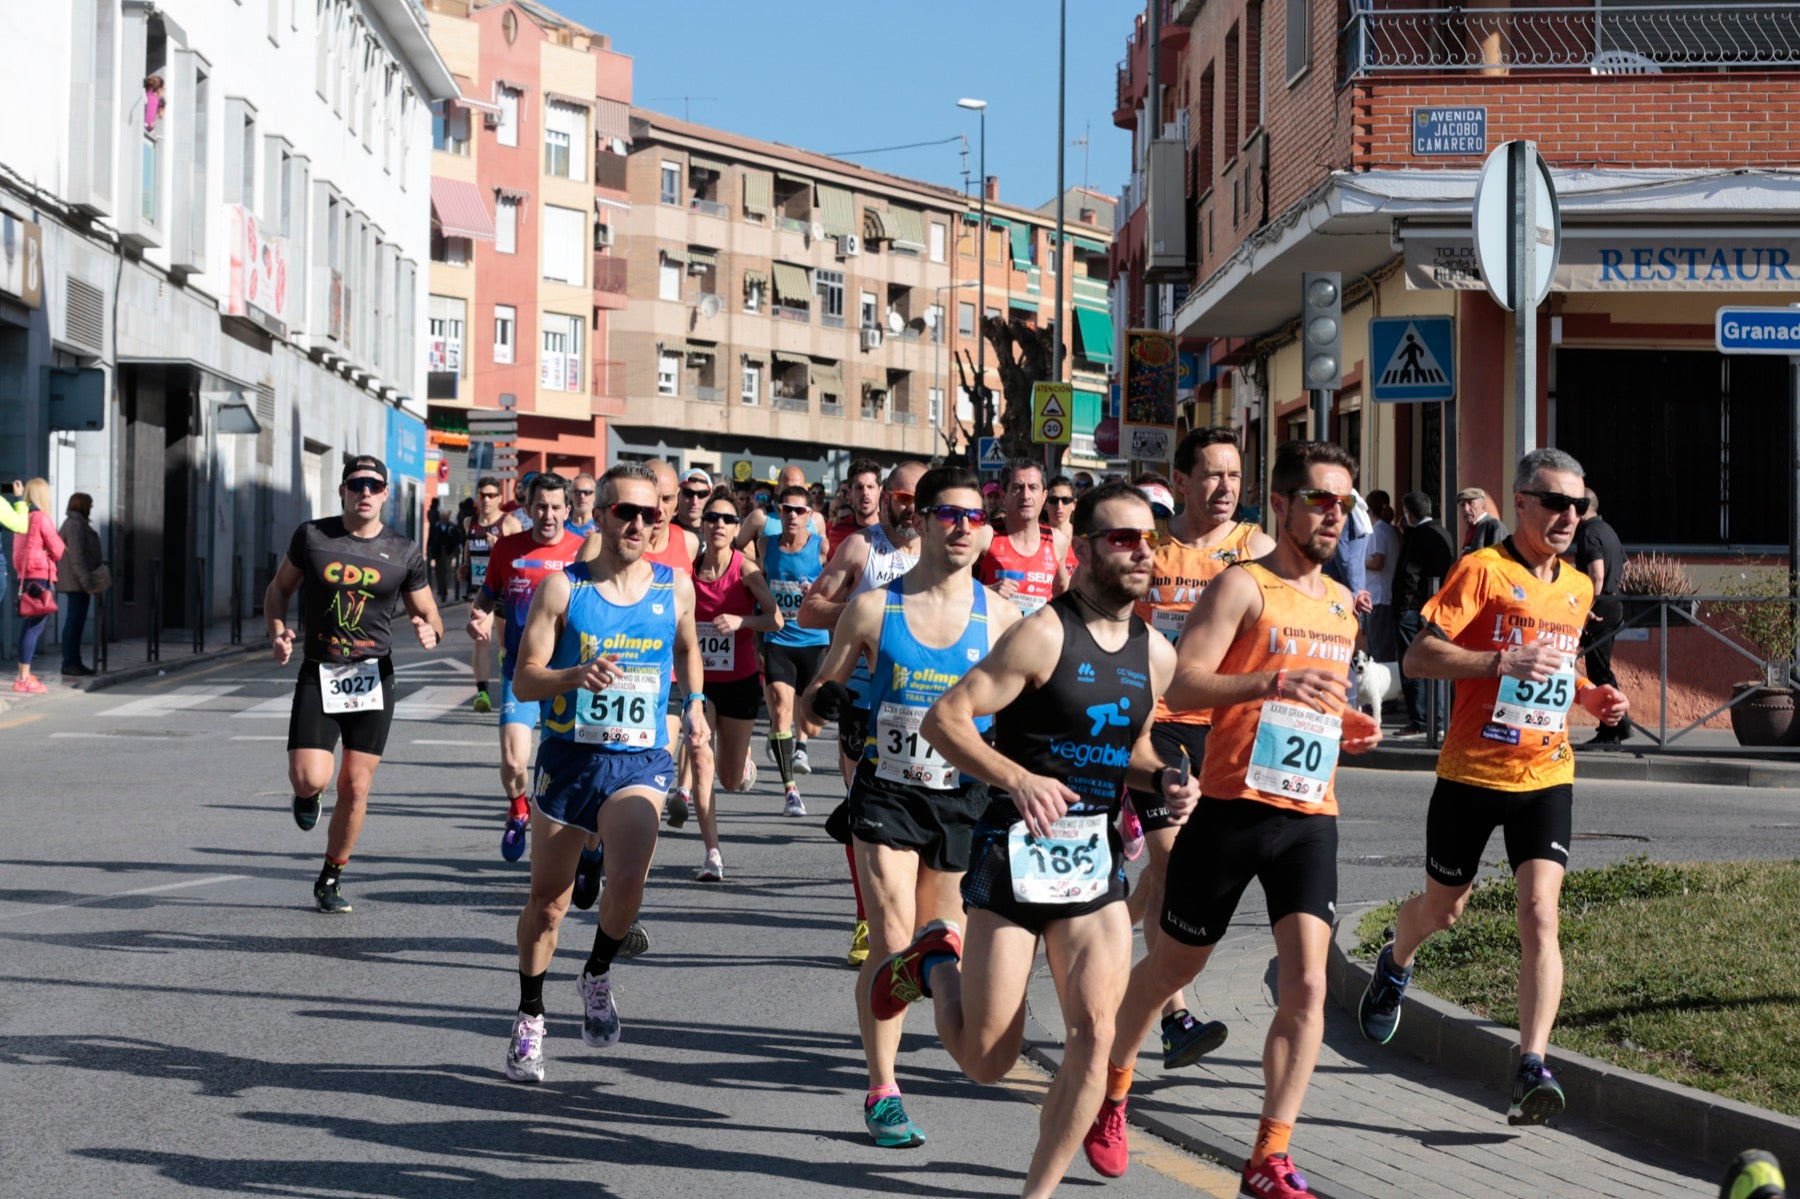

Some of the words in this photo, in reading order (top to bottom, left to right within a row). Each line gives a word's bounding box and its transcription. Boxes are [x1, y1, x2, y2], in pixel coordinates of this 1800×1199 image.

[1430, 110, 1483, 122] AVENIDA
[1434, 122, 1478, 136] JACOBO
[1417, 137, 1483, 152] CAMARERO
[1599, 247, 1800, 282] RESTAUR
[1046, 424, 1059, 433] 20
[323, 561, 382, 586] CDP
[1151, 575, 1171, 587] lub
[1175, 576, 1208, 588] Depo
[776, 593, 803, 608] 208
[1172, 587, 1203, 603] ZU
[1492, 613, 1523, 645] LA
[1508, 614, 1535, 628] Club
[1269, 627, 1298, 656] LA
[1283, 626, 1306, 638] Club
[603, 633, 663, 653] olimpo
[329, 676, 375, 695] 3027
[913, 668, 959, 687] olimp
[906, 693, 925, 703] TRAIL
[1515, 679, 1568, 707] 525
[590, 694, 646, 724] 516
[1281, 736, 1322, 772] 20
[1029, 845, 1095, 875] 186
